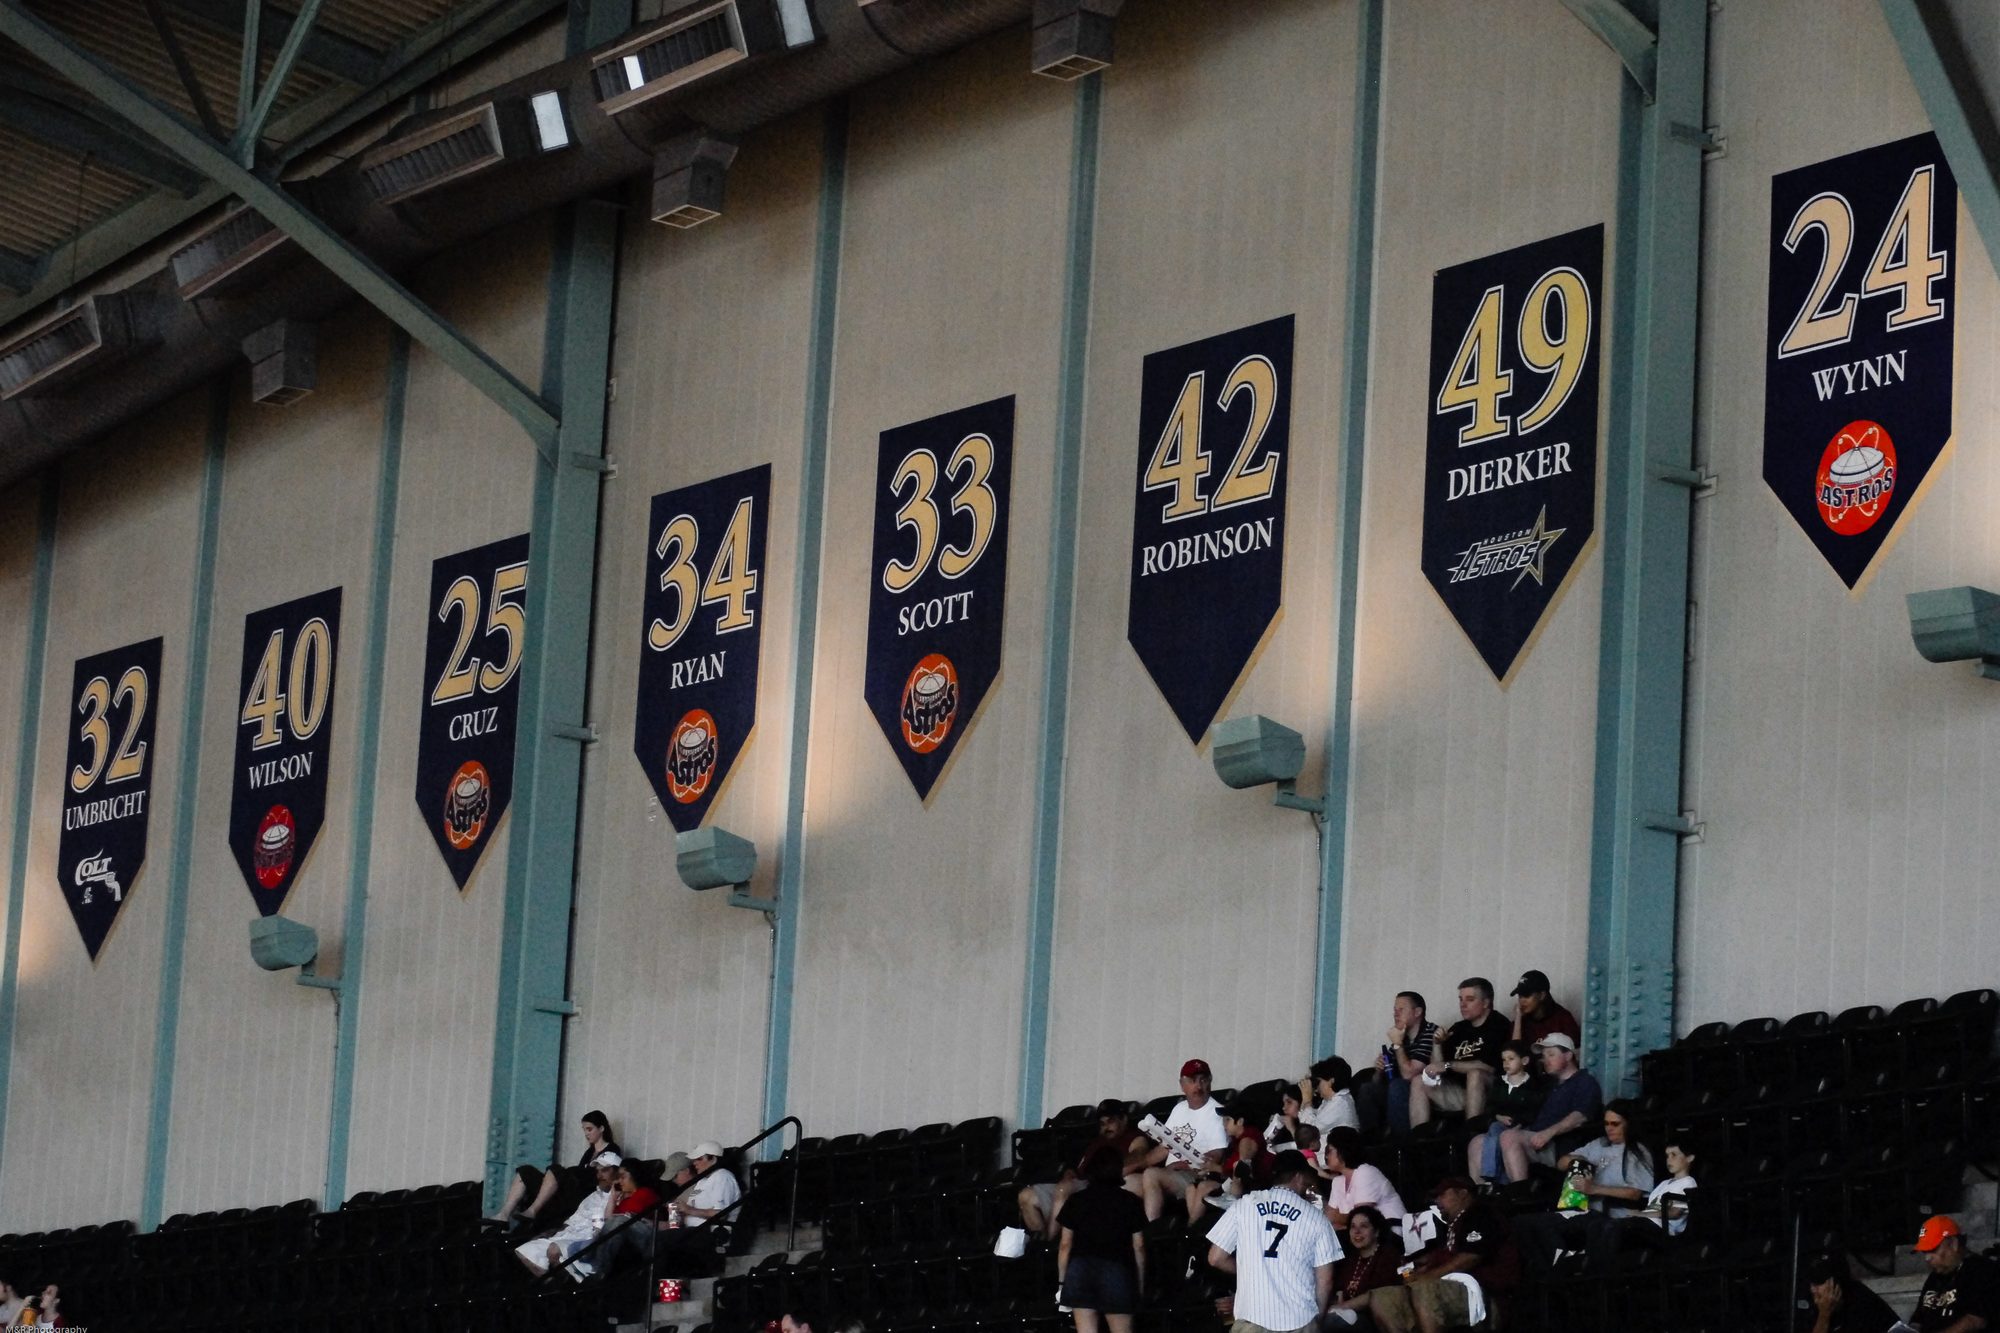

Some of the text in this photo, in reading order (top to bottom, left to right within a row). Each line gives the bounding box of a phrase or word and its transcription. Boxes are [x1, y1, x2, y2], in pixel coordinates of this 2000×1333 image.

[1778, 164, 1947, 359] 24
[1436, 266, 1592, 448] 49
[1811, 350, 1908, 402] WYNN
[1142, 354, 1281, 523] 42
[1447, 441, 1572, 501] DIERKER
[1819, 467, 1894, 508] ASTROS
[883, 432, 996, 594] 33
[1482, 528, 1532, 546] HOUSTON
[648, 496, 758, 652] 34
[1141, 517, 1274, 577] ROBINSON
[430, 560, 528, 706] 25
[898, 590, 974, 636] SCOTT
[241, 617, 332, 751] 40
[670, 650, 727, 690] RYAN
[71, 665, 149, 794] 32
[448, 706, 499, 742] CRUZ
[248, 751, 314, 790] WILSON
[66, 790, 146, 831] UMBRICHT
[1256, 1201, 1302, 1222] BIGGIO
[1264, 1220, 1289, 1259] 7
